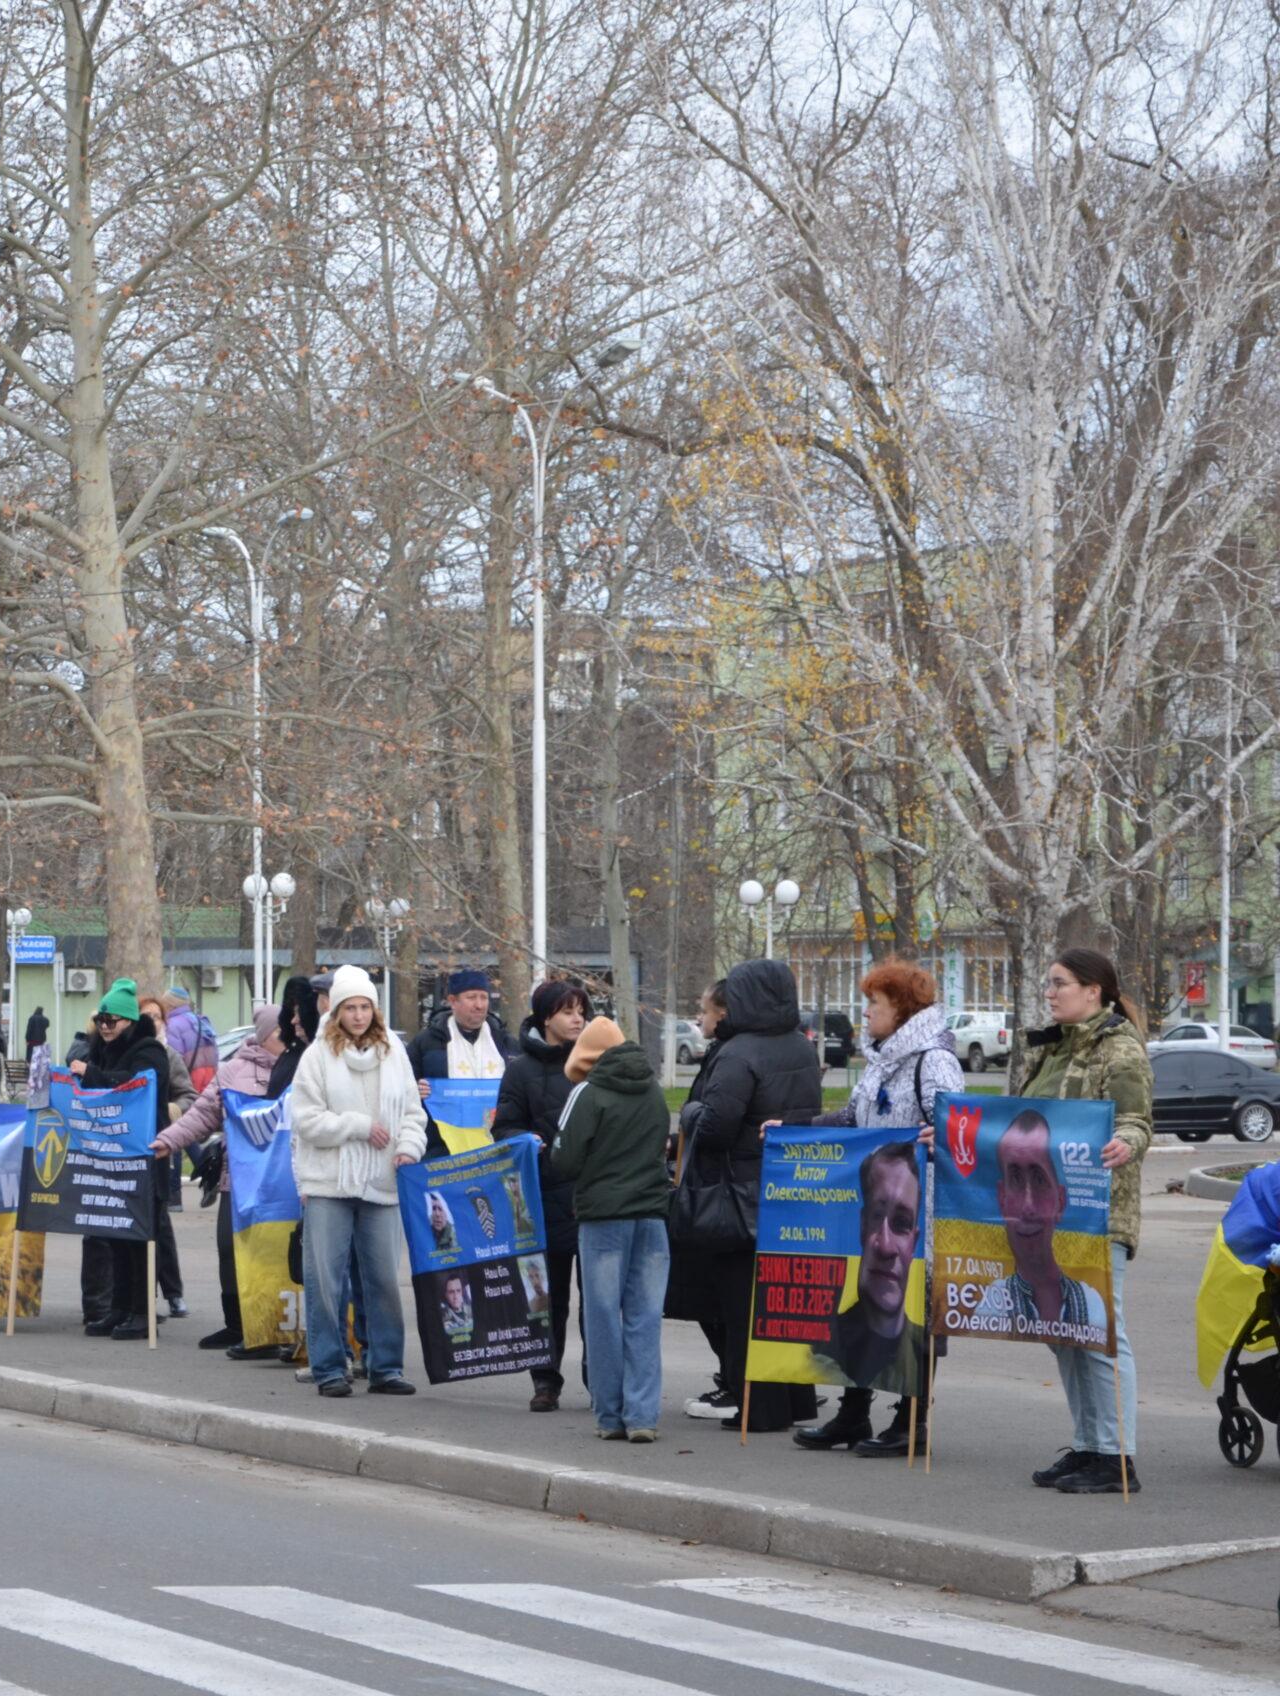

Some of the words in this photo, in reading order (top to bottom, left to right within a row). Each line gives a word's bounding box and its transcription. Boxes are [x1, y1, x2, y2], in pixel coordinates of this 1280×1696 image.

[1059, 1142, 1093, 1166] 122
[793, 1163, 828, 1180] Антон
[765, 1182, 858, 1205] Олександрович
[947, 1282, 1014, 1311] ВЄХОВ
[945, 1309, 1012, 1332] Олексій
